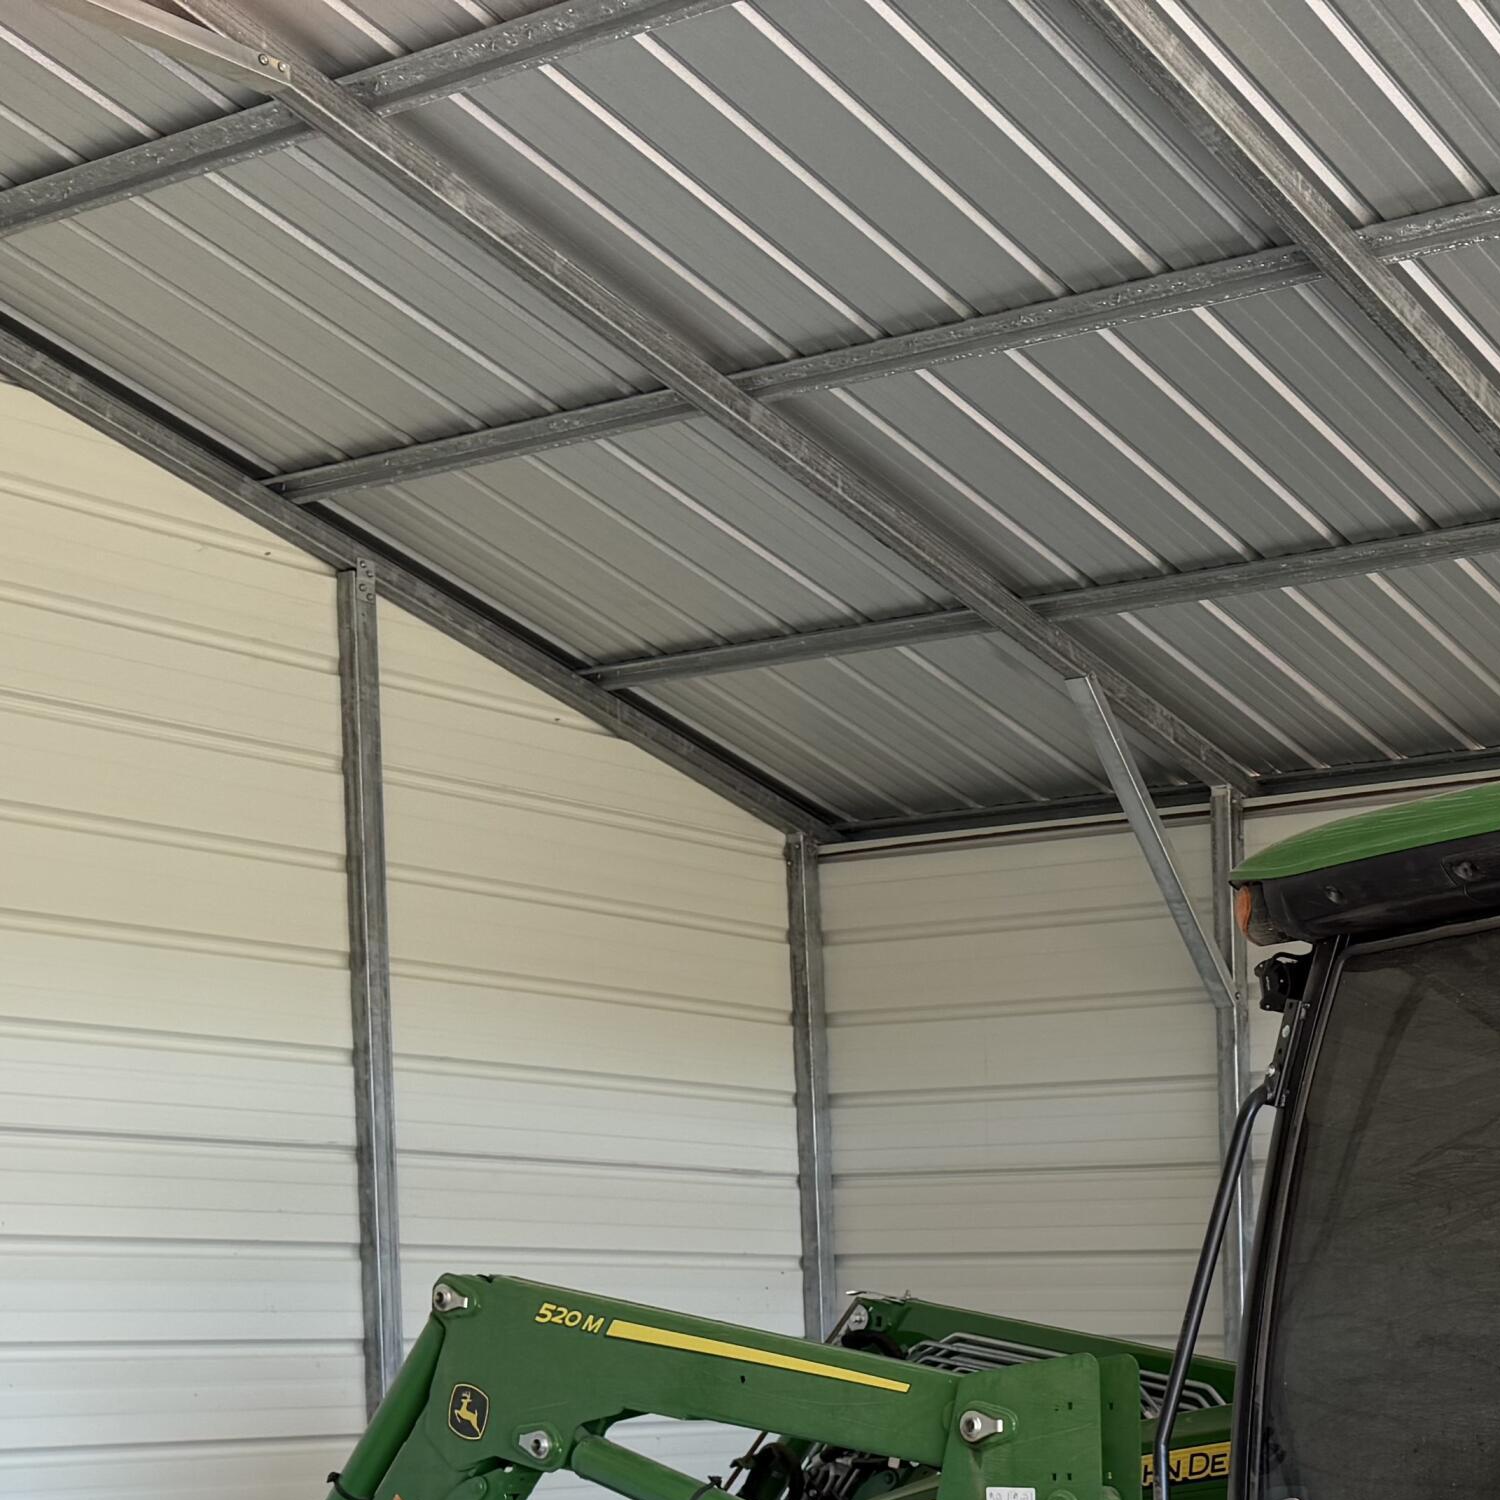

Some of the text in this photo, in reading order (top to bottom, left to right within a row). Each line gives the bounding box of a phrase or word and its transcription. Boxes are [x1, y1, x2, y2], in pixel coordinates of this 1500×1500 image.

[535, 1302, 605, 1334] 520 M
[1188, 1452, 1228, 1477] DE
